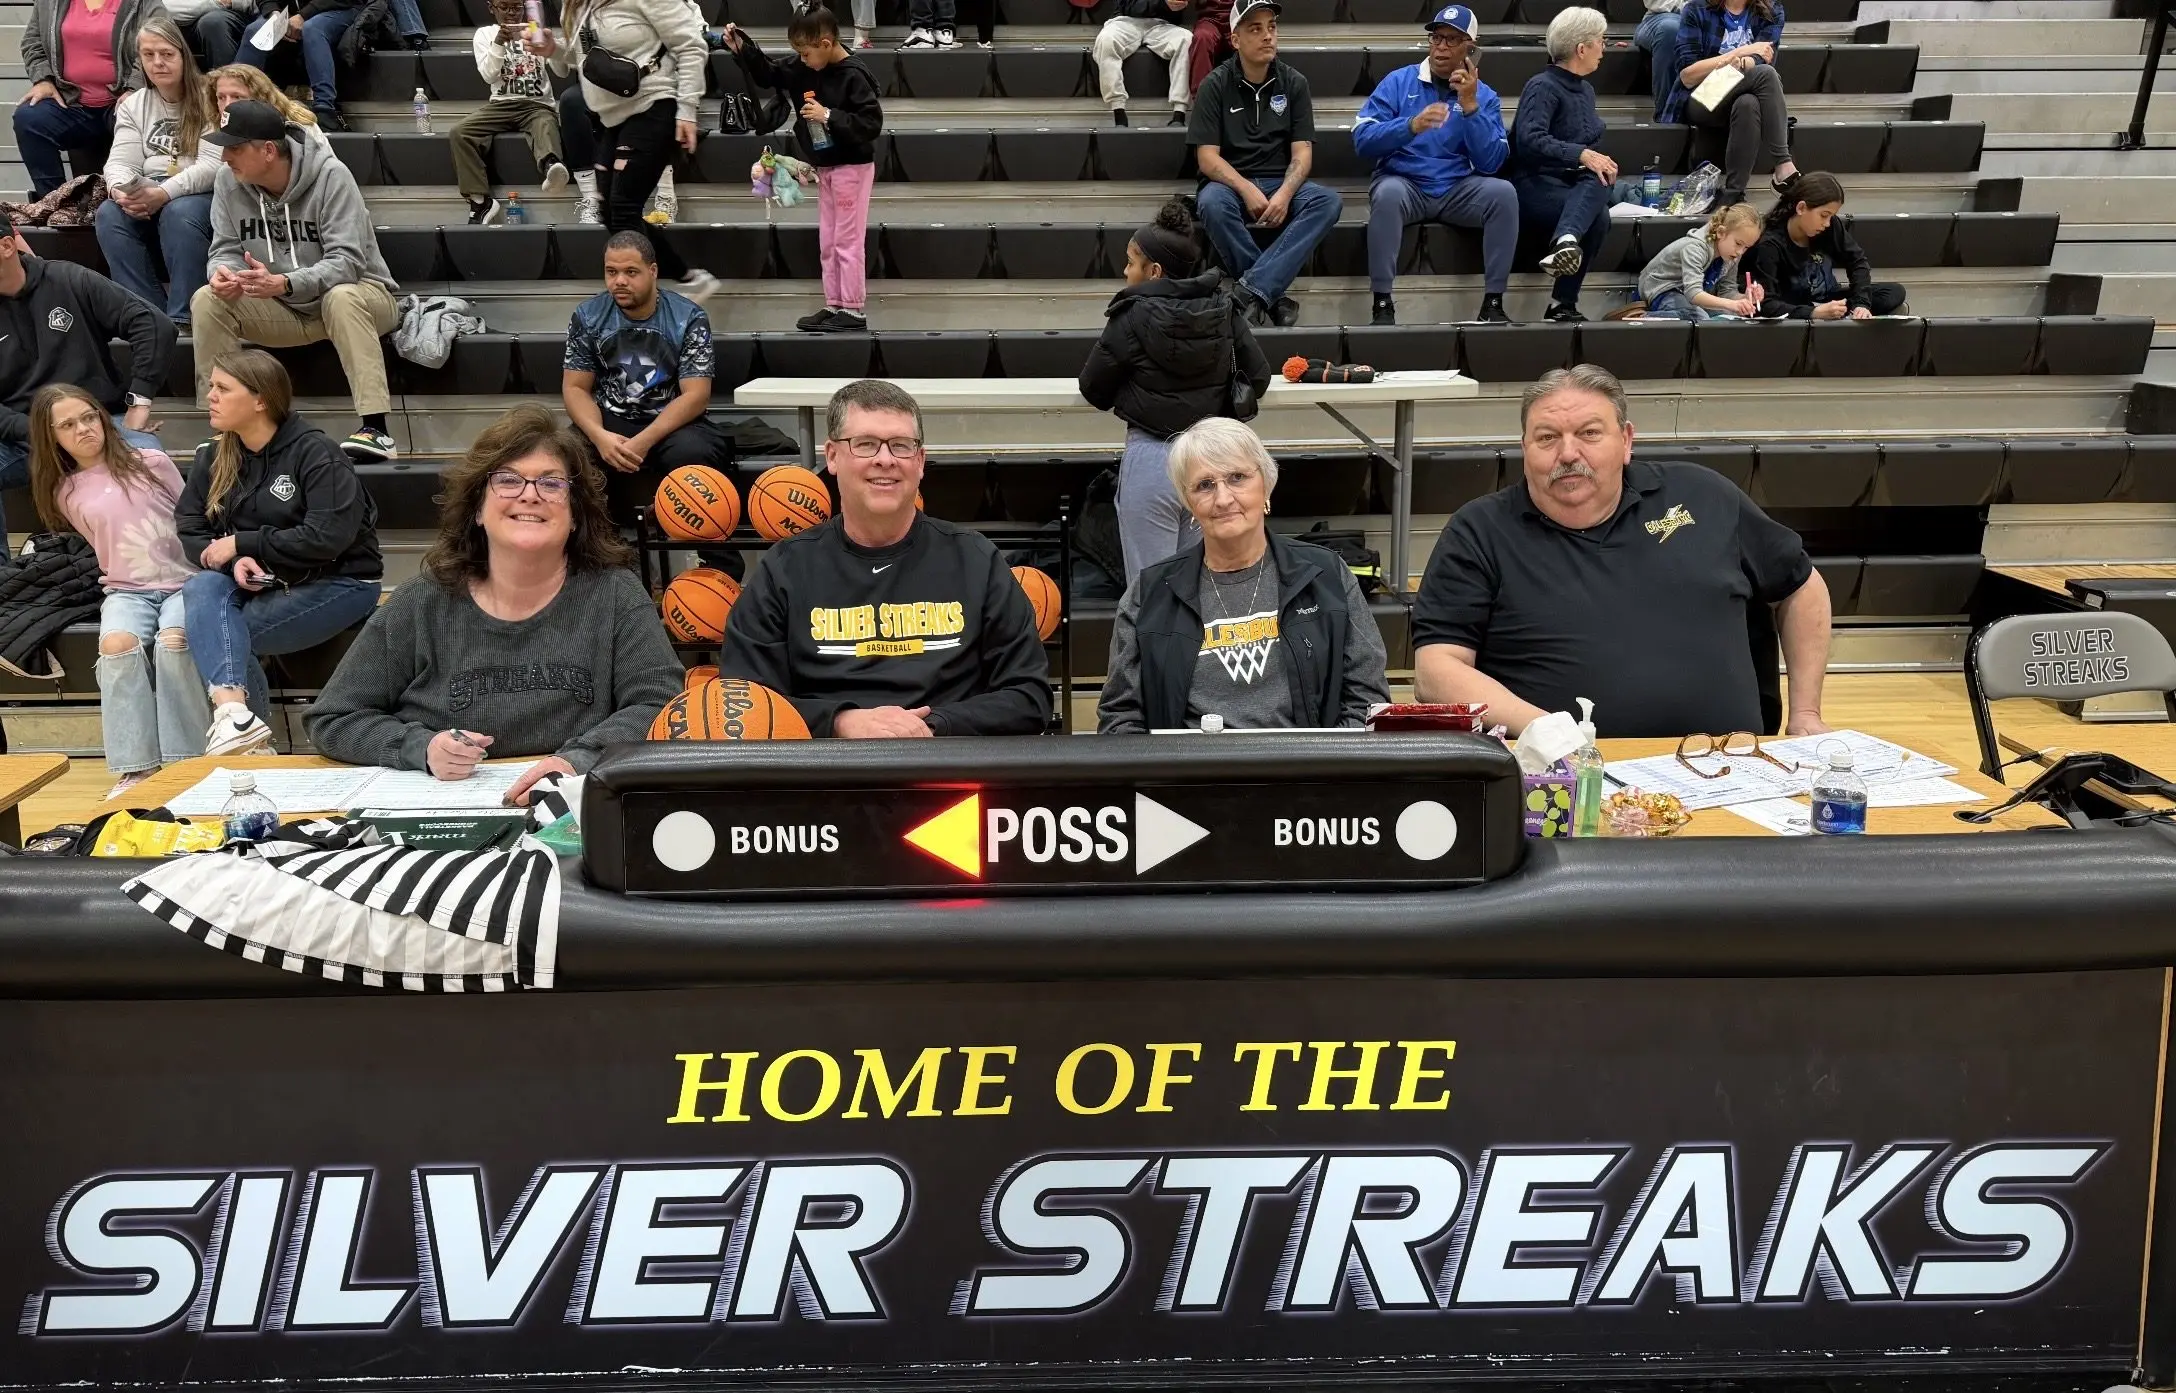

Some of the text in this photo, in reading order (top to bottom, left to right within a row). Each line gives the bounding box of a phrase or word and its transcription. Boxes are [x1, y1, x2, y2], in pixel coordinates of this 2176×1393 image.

[240, 218, 320, 242] HUSTLE
[683, 473, 719, 505] NCAA
[787, 487, 829, 523] Wilson
[664, 484, 705, 531] Wilson
[779, 516, 806, 535] NC
[810, 600, 965, 640] SILVER STREAKS
[1201, 616, 1279, 650] LESBU
[866, 643, 912, 653] BASKETBALL
[2030, 627, 2115, 657] SILVER
[449, 663, 595, 712] STREAKS
[2023, 655, 2130, 687] STREAKS
[667, 692, 691, 739] NCA
[720, 679, 753, 739] Wilso
[730, 824, 840, 854] BONUS
[986, 806, 1129, 864] POSS
[1273, 817, 1381, 847] BONUS
[666, 1040, 1457, 1125] HOME OF THE
[26, 1140, 2115, 1336] SILVER STREAKS
